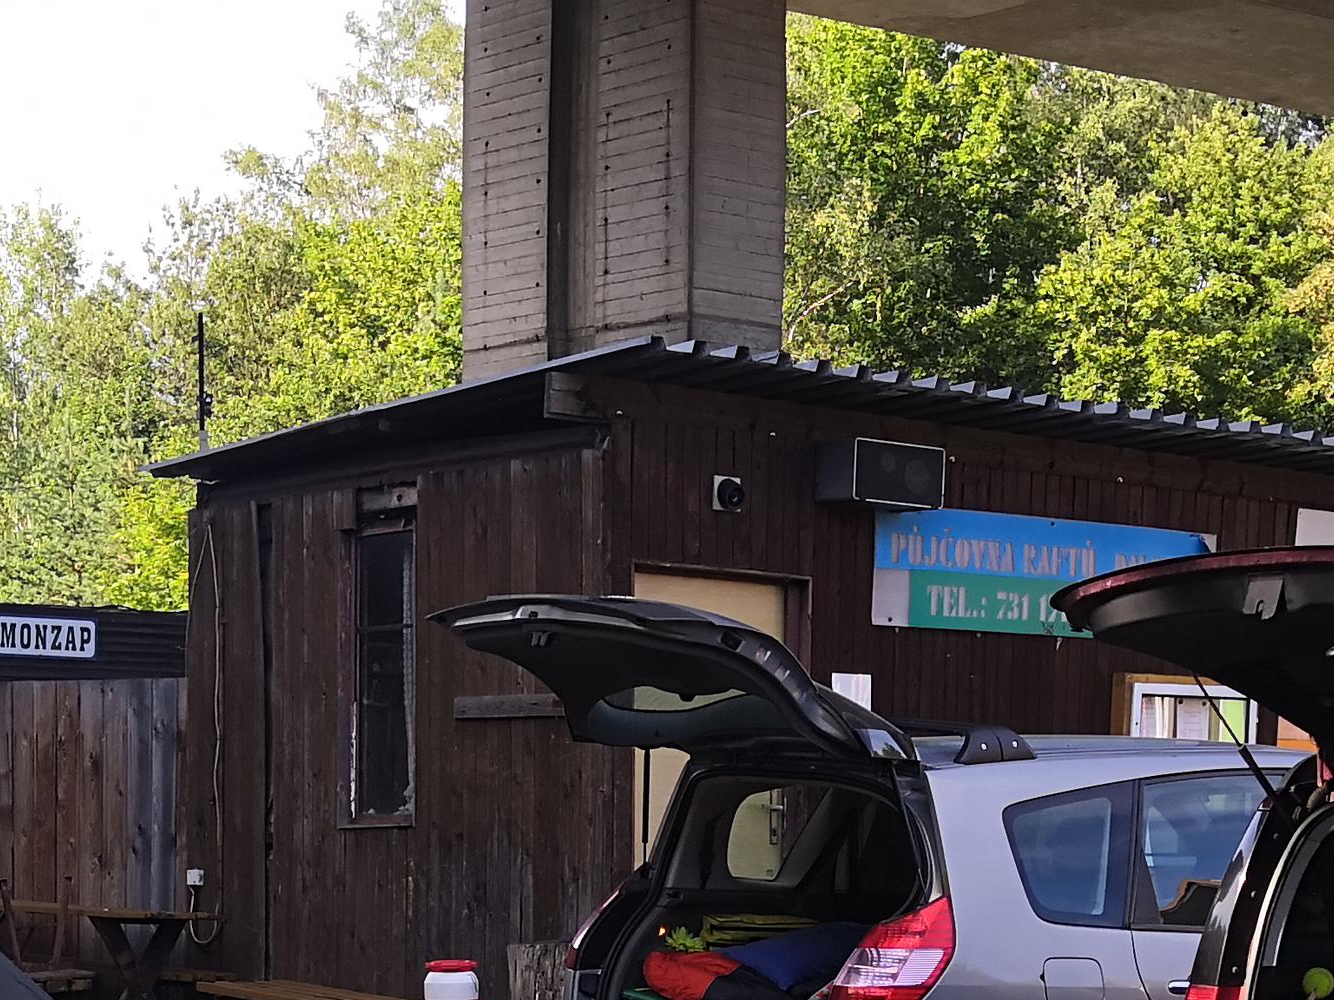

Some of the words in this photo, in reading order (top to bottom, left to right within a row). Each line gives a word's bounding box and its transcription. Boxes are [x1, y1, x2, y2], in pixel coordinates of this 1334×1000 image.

[1023, 539, 1097, 578] RAFTŮ
[927, 584, 987, 618] TEL.:
[996, 591, 1030, 621] 731
[0, 621, 92, 652] MONZAP
